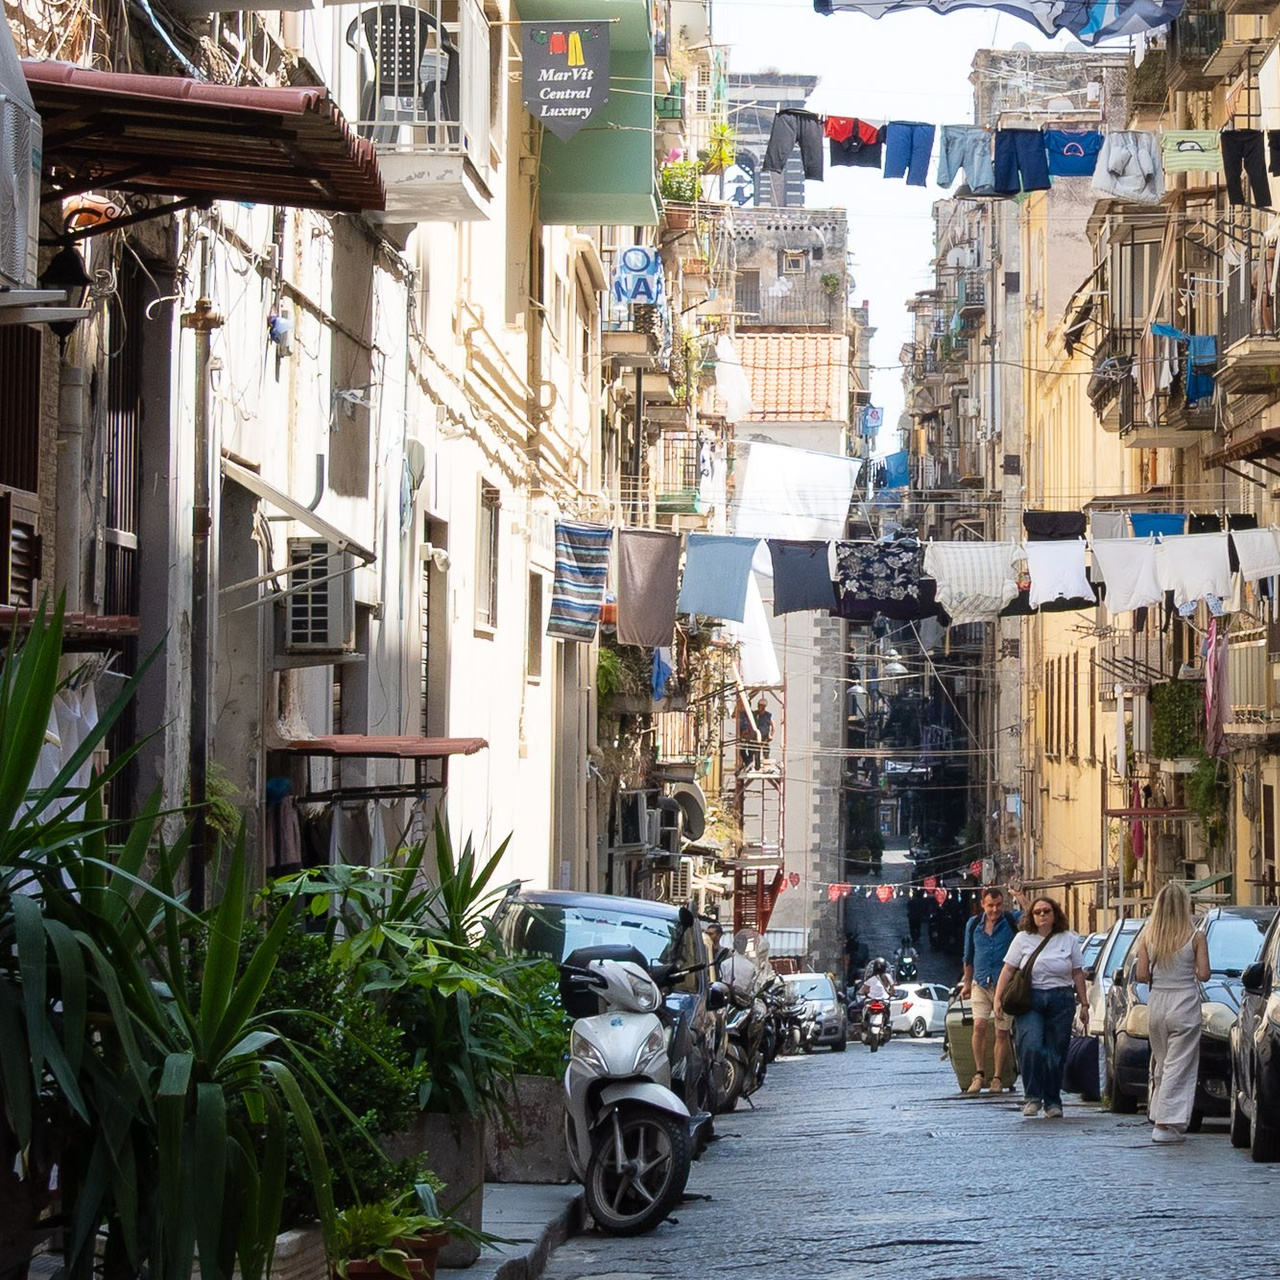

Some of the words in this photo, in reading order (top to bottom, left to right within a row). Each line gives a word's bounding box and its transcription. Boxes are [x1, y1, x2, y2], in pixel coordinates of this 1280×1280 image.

[537, 67, 594, 82] MarVit
[539, 86, 593, 100] Central
[540, 104, 593, 120] Luxury
